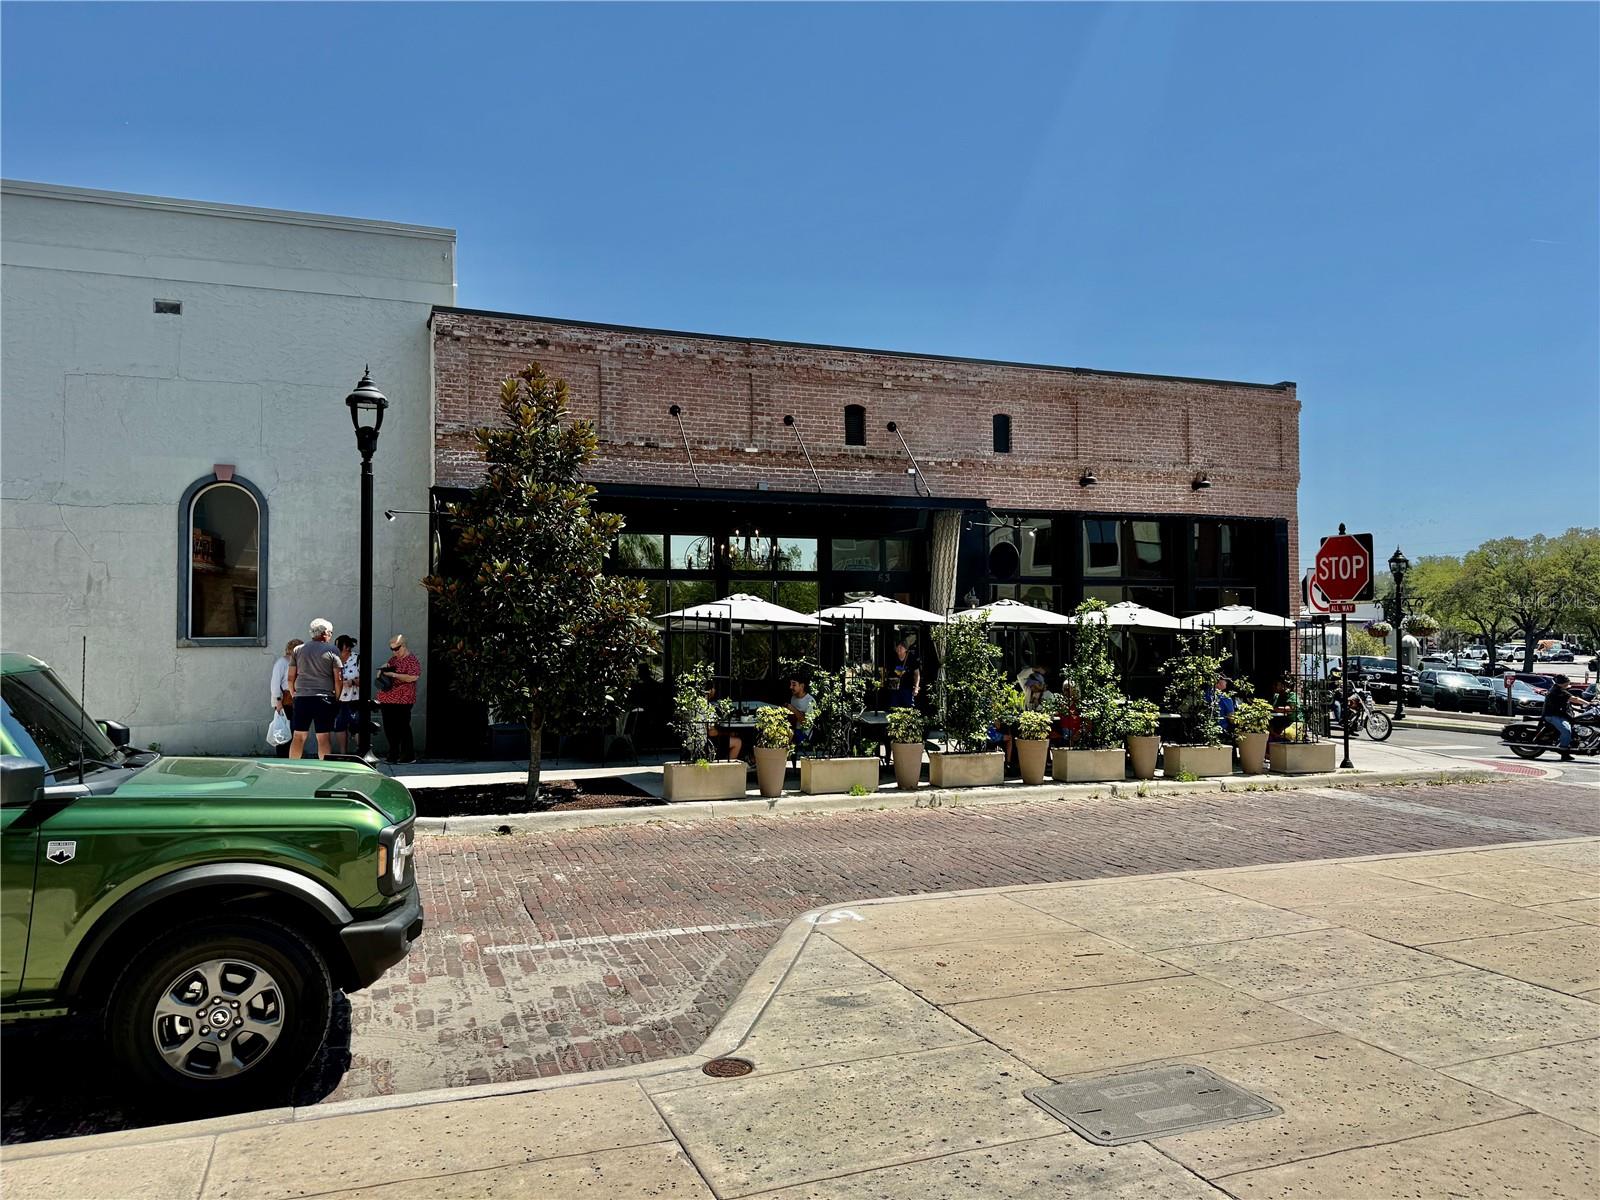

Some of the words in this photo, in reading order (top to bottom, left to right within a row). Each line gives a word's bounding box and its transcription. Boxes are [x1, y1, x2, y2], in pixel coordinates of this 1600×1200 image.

[1319, 555, 1364, 580] STOP
[1330, 604, 1340, 612] ALL
[1341, 604, 1354, 612] WAY
